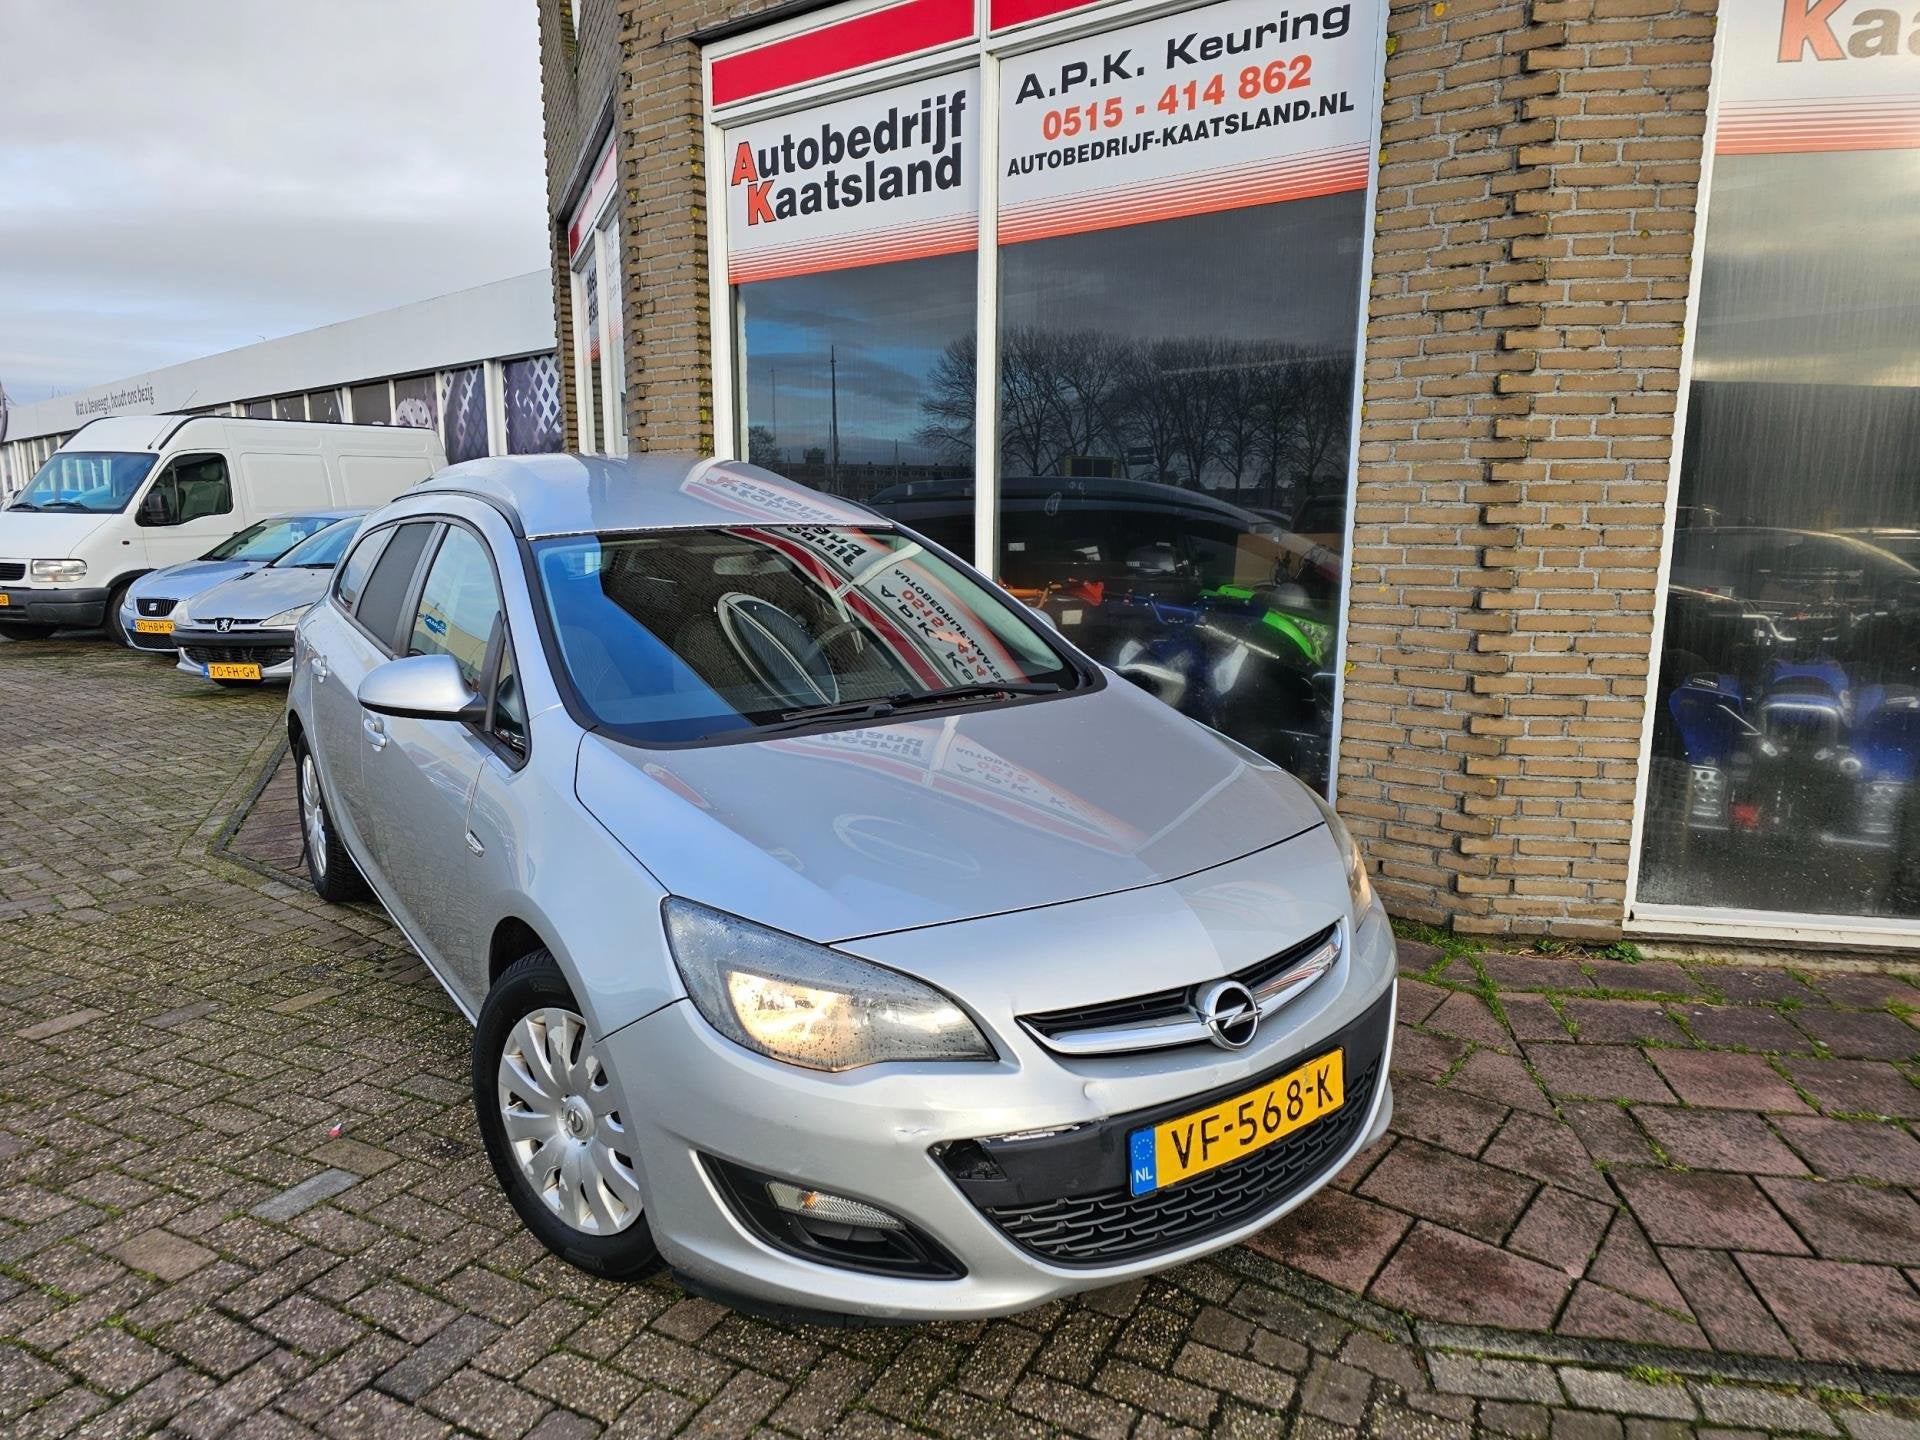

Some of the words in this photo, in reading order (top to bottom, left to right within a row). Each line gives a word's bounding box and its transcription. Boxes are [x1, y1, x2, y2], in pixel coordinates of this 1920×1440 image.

[1015, 49, 1145, 104] A.P.K.
[1166, 4, 1351, 69] Keuring
[1777, 0, 1920, 63] Ka
[731, 90, 966, 186] Autobedrijf
[1007, 91, 1354, 176] AUTOBEDRIJF-KAATSLAND.NL
[1042, 97, 1124, 140] 0515
[1157, 73, 1225, 115] 414
[1238, 54, 1312, 99] 862
[747, 142, 962, 226] Kaatsland
[137, 381, 154, 405] bezig
[1171, 1064, 1334, 1170] VF-568-K
[1135, 1169, 1153, 1183] NL
